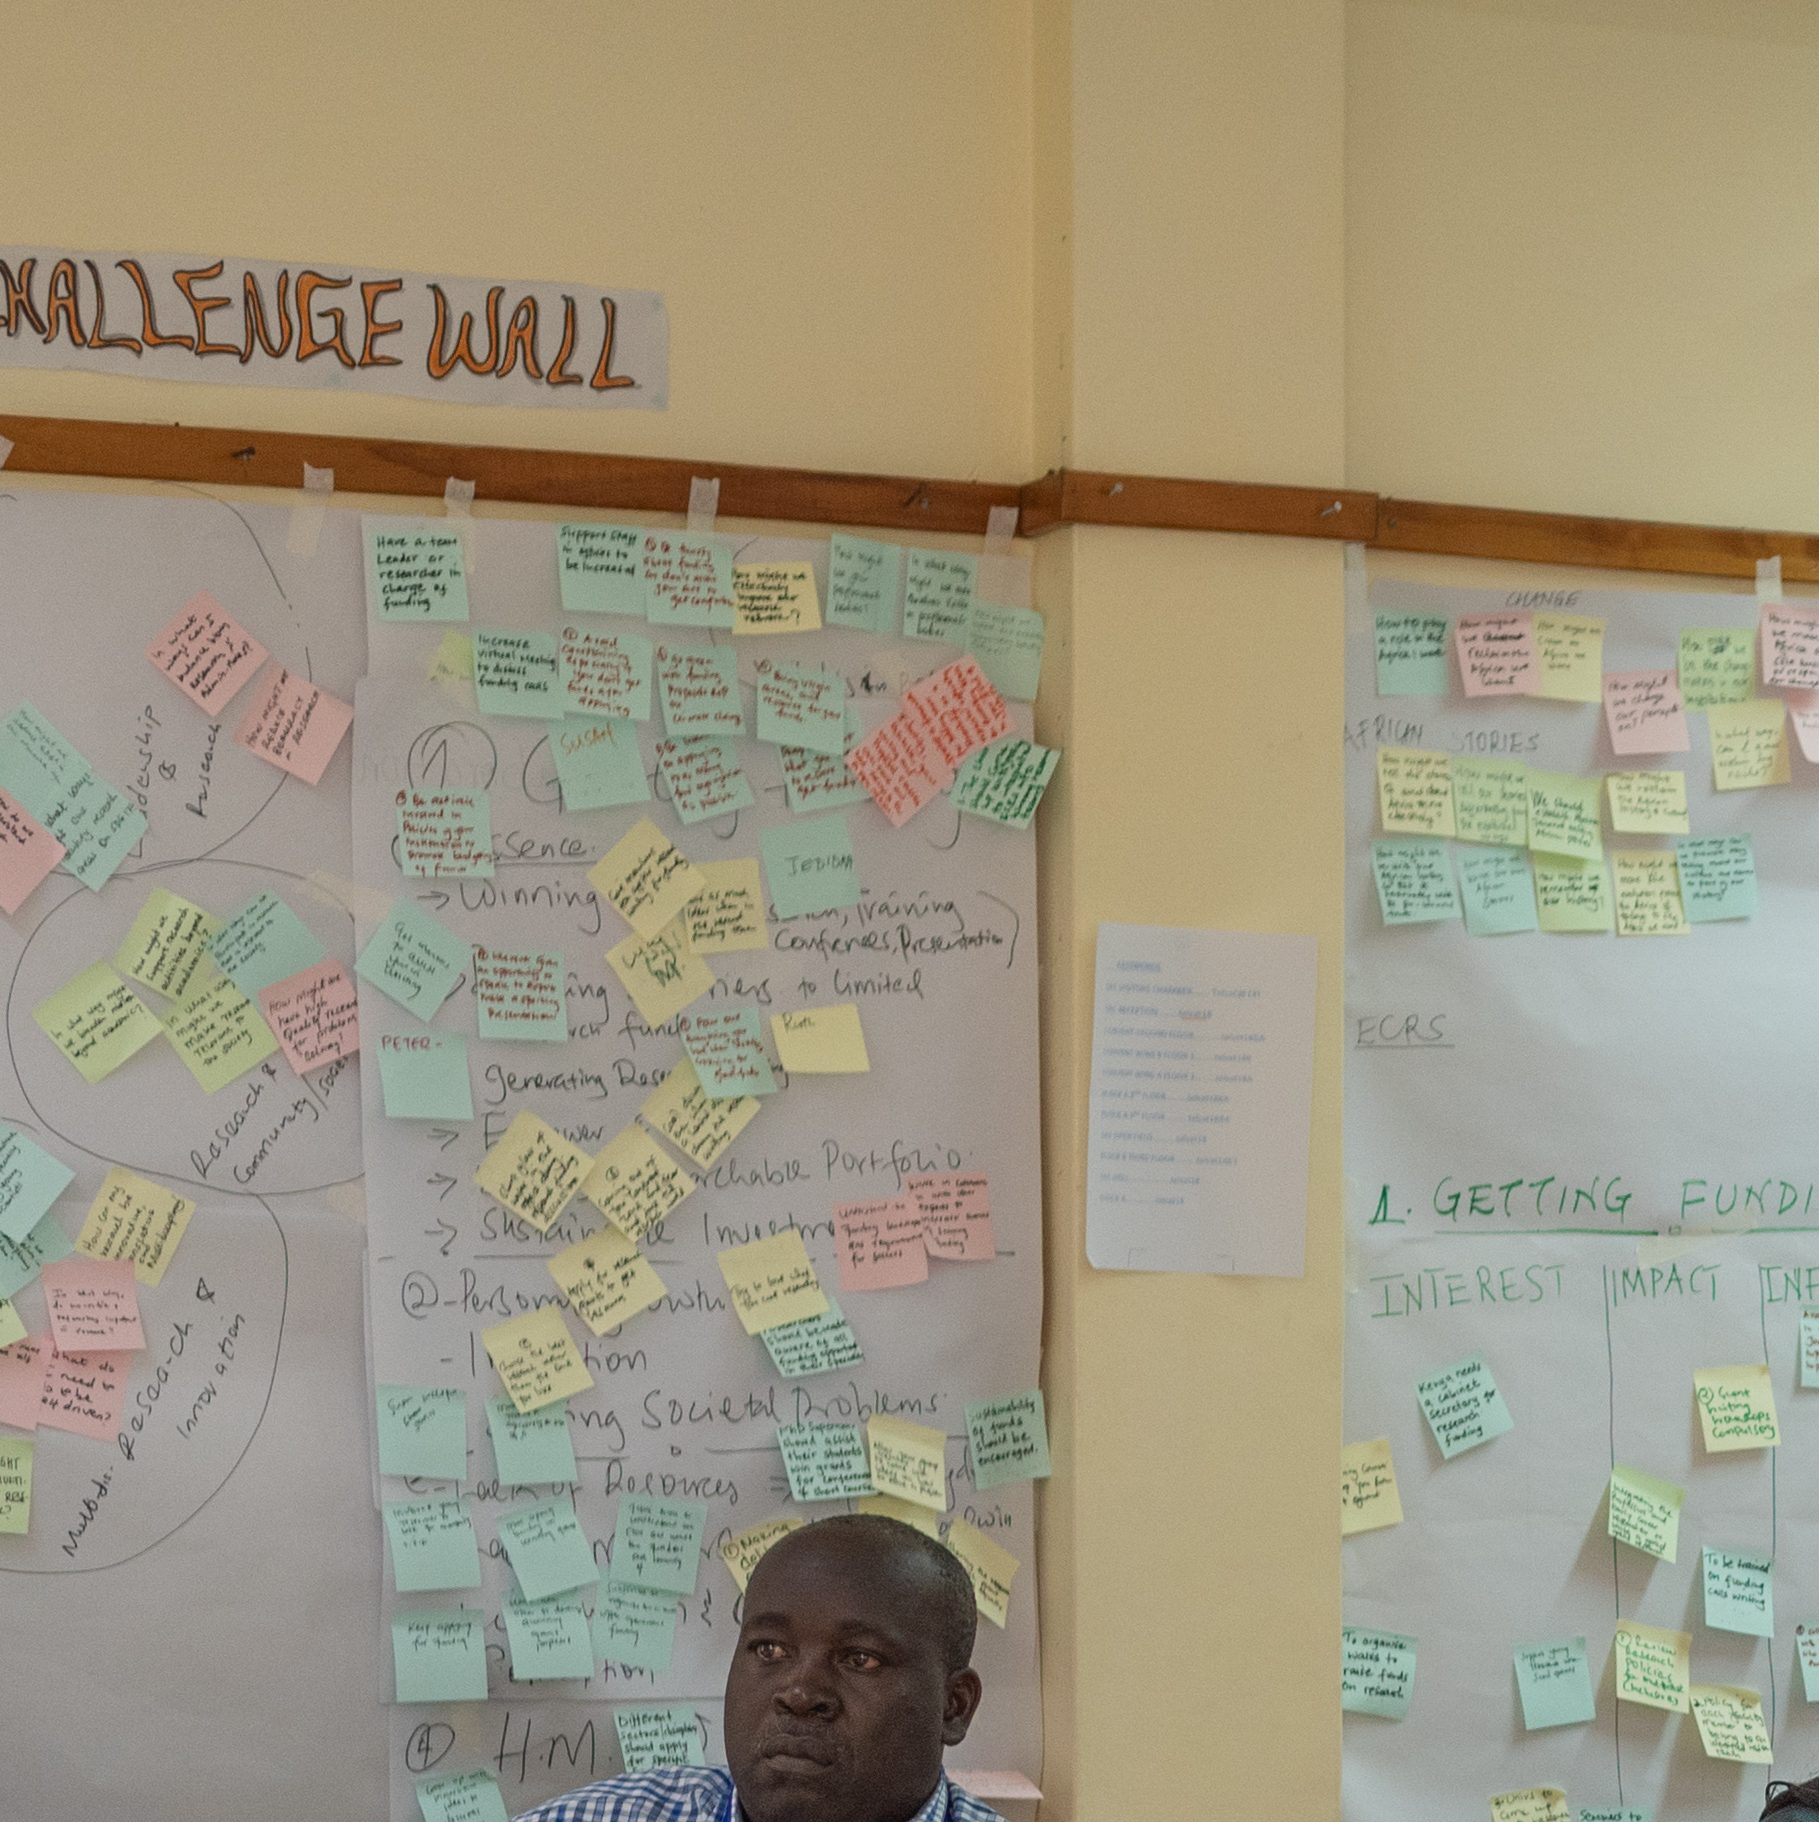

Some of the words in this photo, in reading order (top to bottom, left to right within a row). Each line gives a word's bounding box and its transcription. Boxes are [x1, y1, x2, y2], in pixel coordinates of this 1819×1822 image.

[0, 255, 402, 368] HALLENGE
[427, 281, 643, 395] WALL
[377, 536, 408, 548] Have
[459, 880, 601, 935] Winning
[1434, 1175, 1632, 1223] GETTING
[1370, 1264, 1566, 1318] INTEREST
[1612, 1263, 1722, 1308] IMPACT
[1705, 1553, 1719, 1566] To
